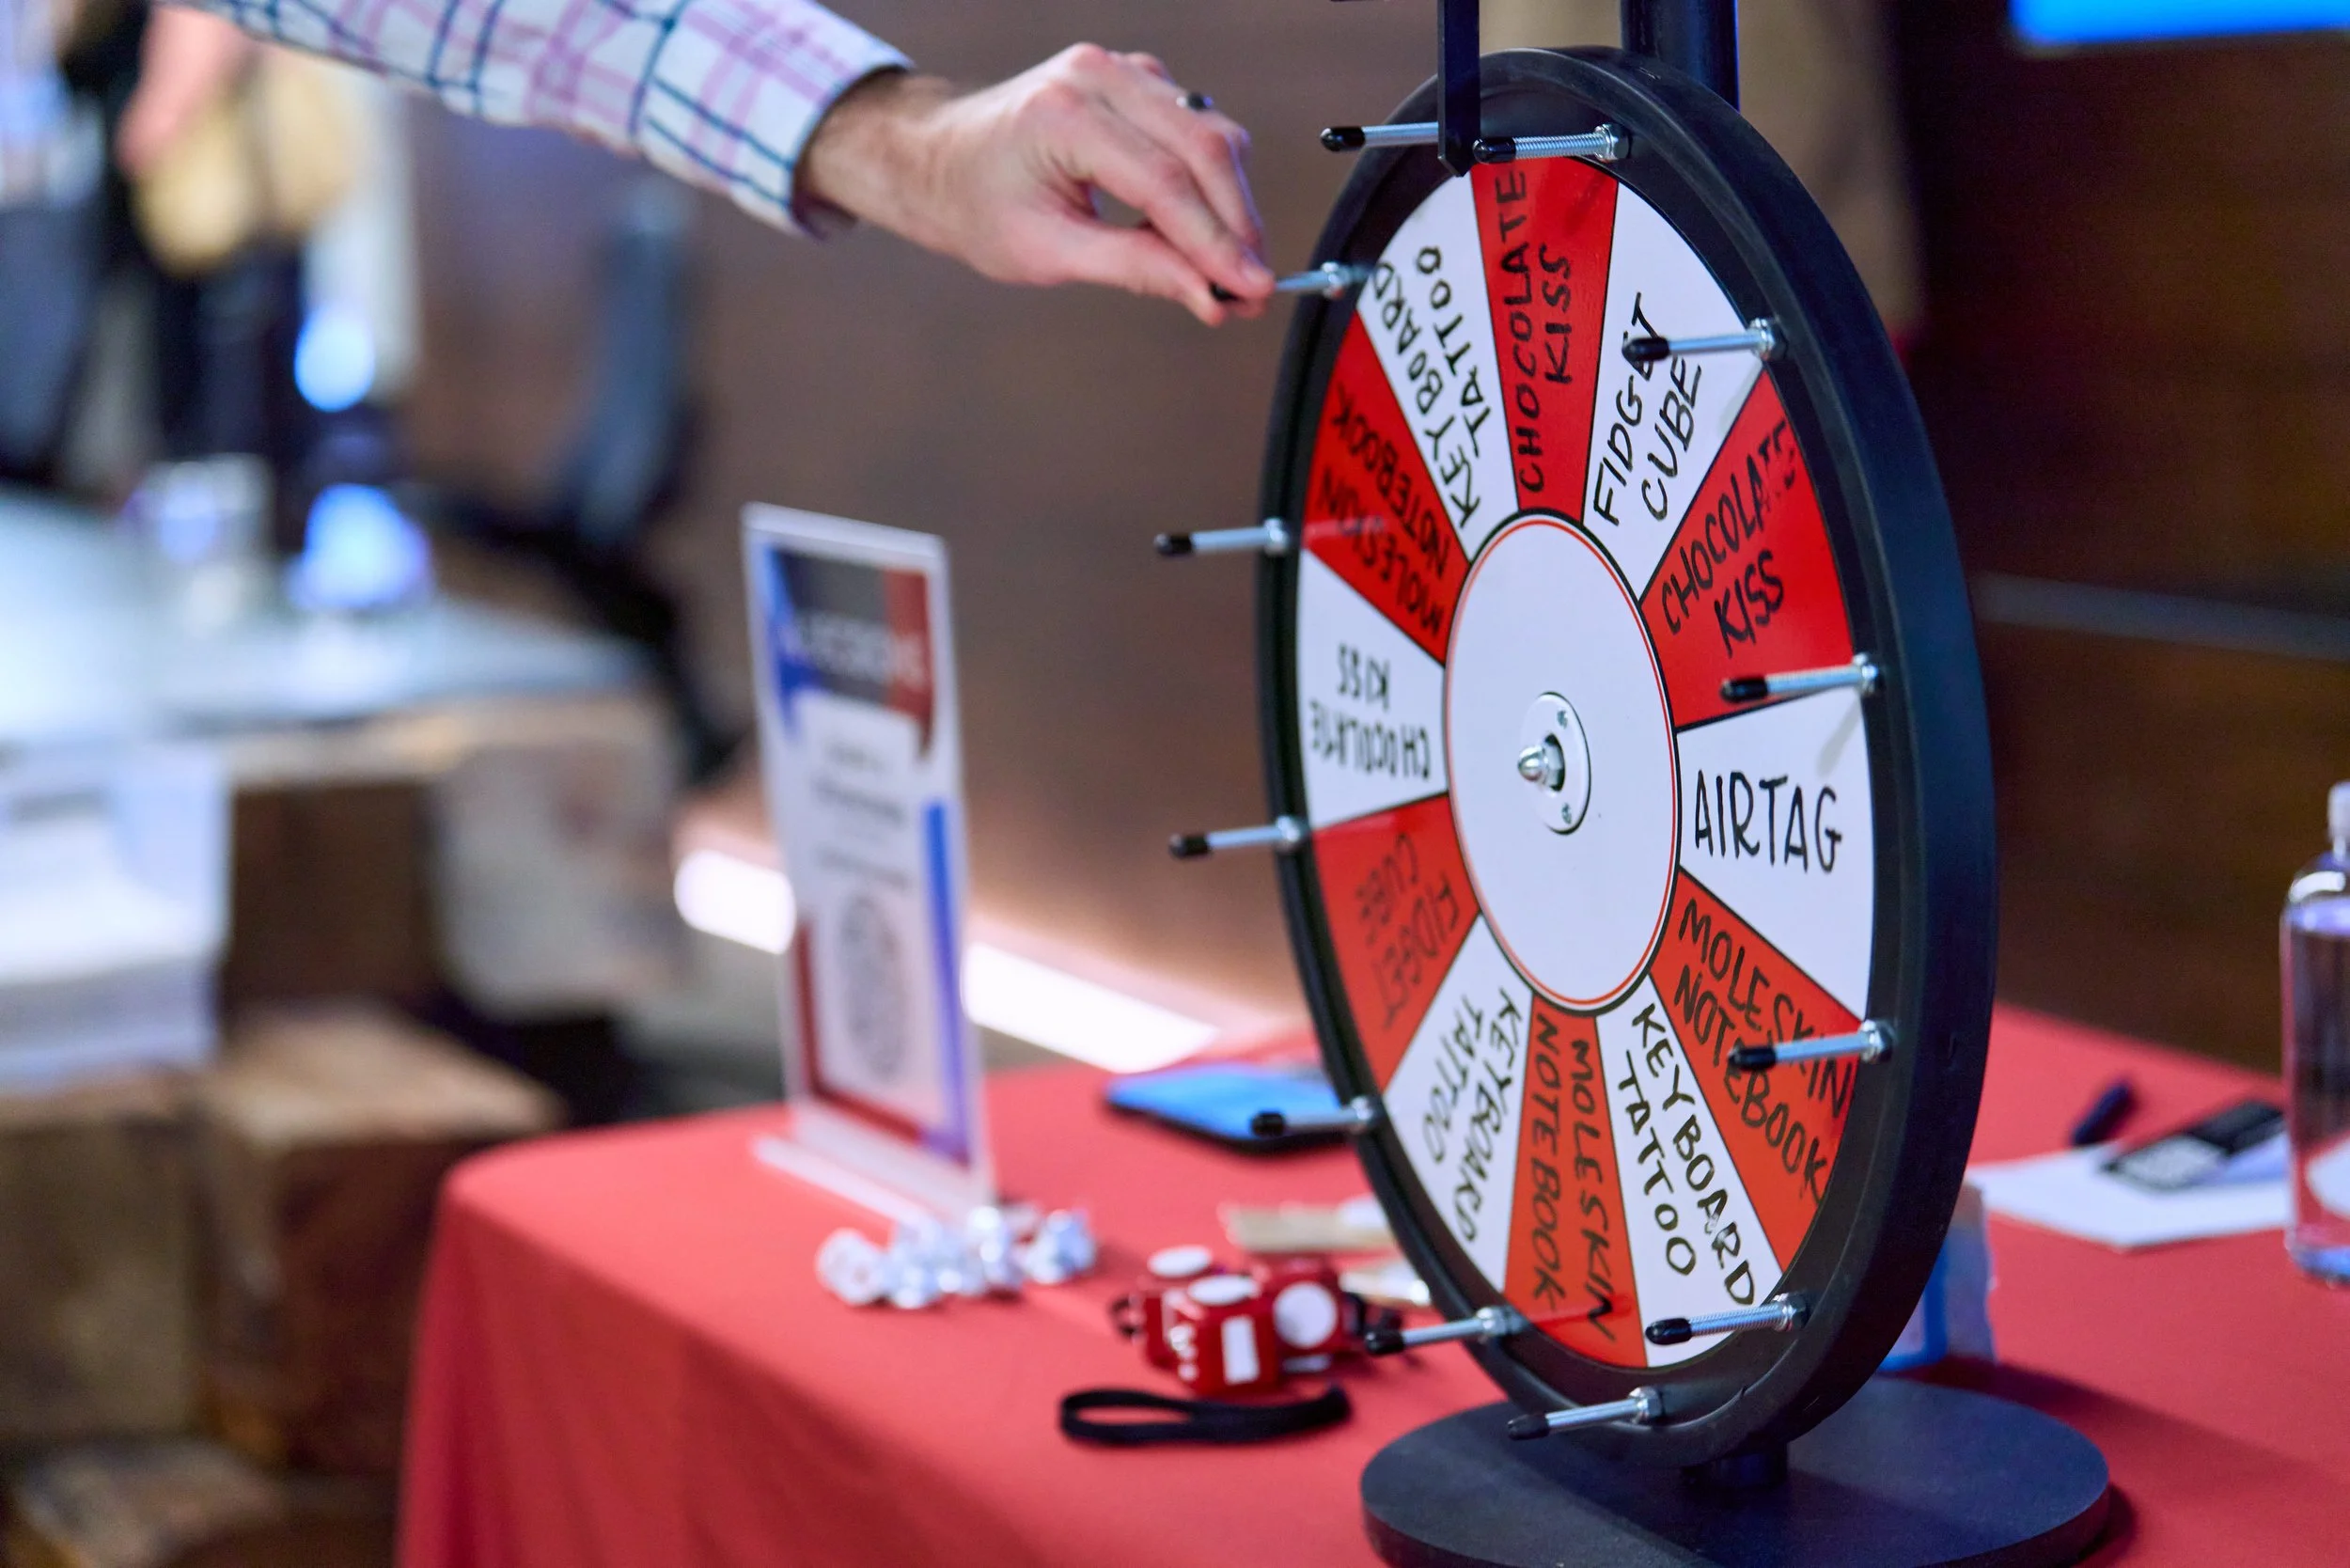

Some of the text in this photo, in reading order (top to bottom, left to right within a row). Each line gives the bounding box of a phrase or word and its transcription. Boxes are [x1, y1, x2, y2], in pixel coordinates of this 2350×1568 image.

[1372, 261, 1481, 529] KEYBOARD
[1416, 246, 1491, 460] TATTOO
[1495, 169, 1545, 494] CHOCOLATE
[1538, 242, 1573, 384] KISS
[1641, 353, 1702, 522] CUBE
[1337, 643, 1390, 713] KISS
[1714, 549, 1784, 659] KISS
[1695, 769, 1842, 873] AIRTAG
[1423, 994, 1483, 1164] TATTOO
[1453, 987, 1523, 1242] KEYBOARD
[1532, 1012, 1565, 1310] NOTEBOOK
[1618, 1049, 1697, 1276] TATTOO
[1632, 1003, 1755, 1306] KEYBOARD
[1571, 1039, 1616, 1341] MOLESKIN
